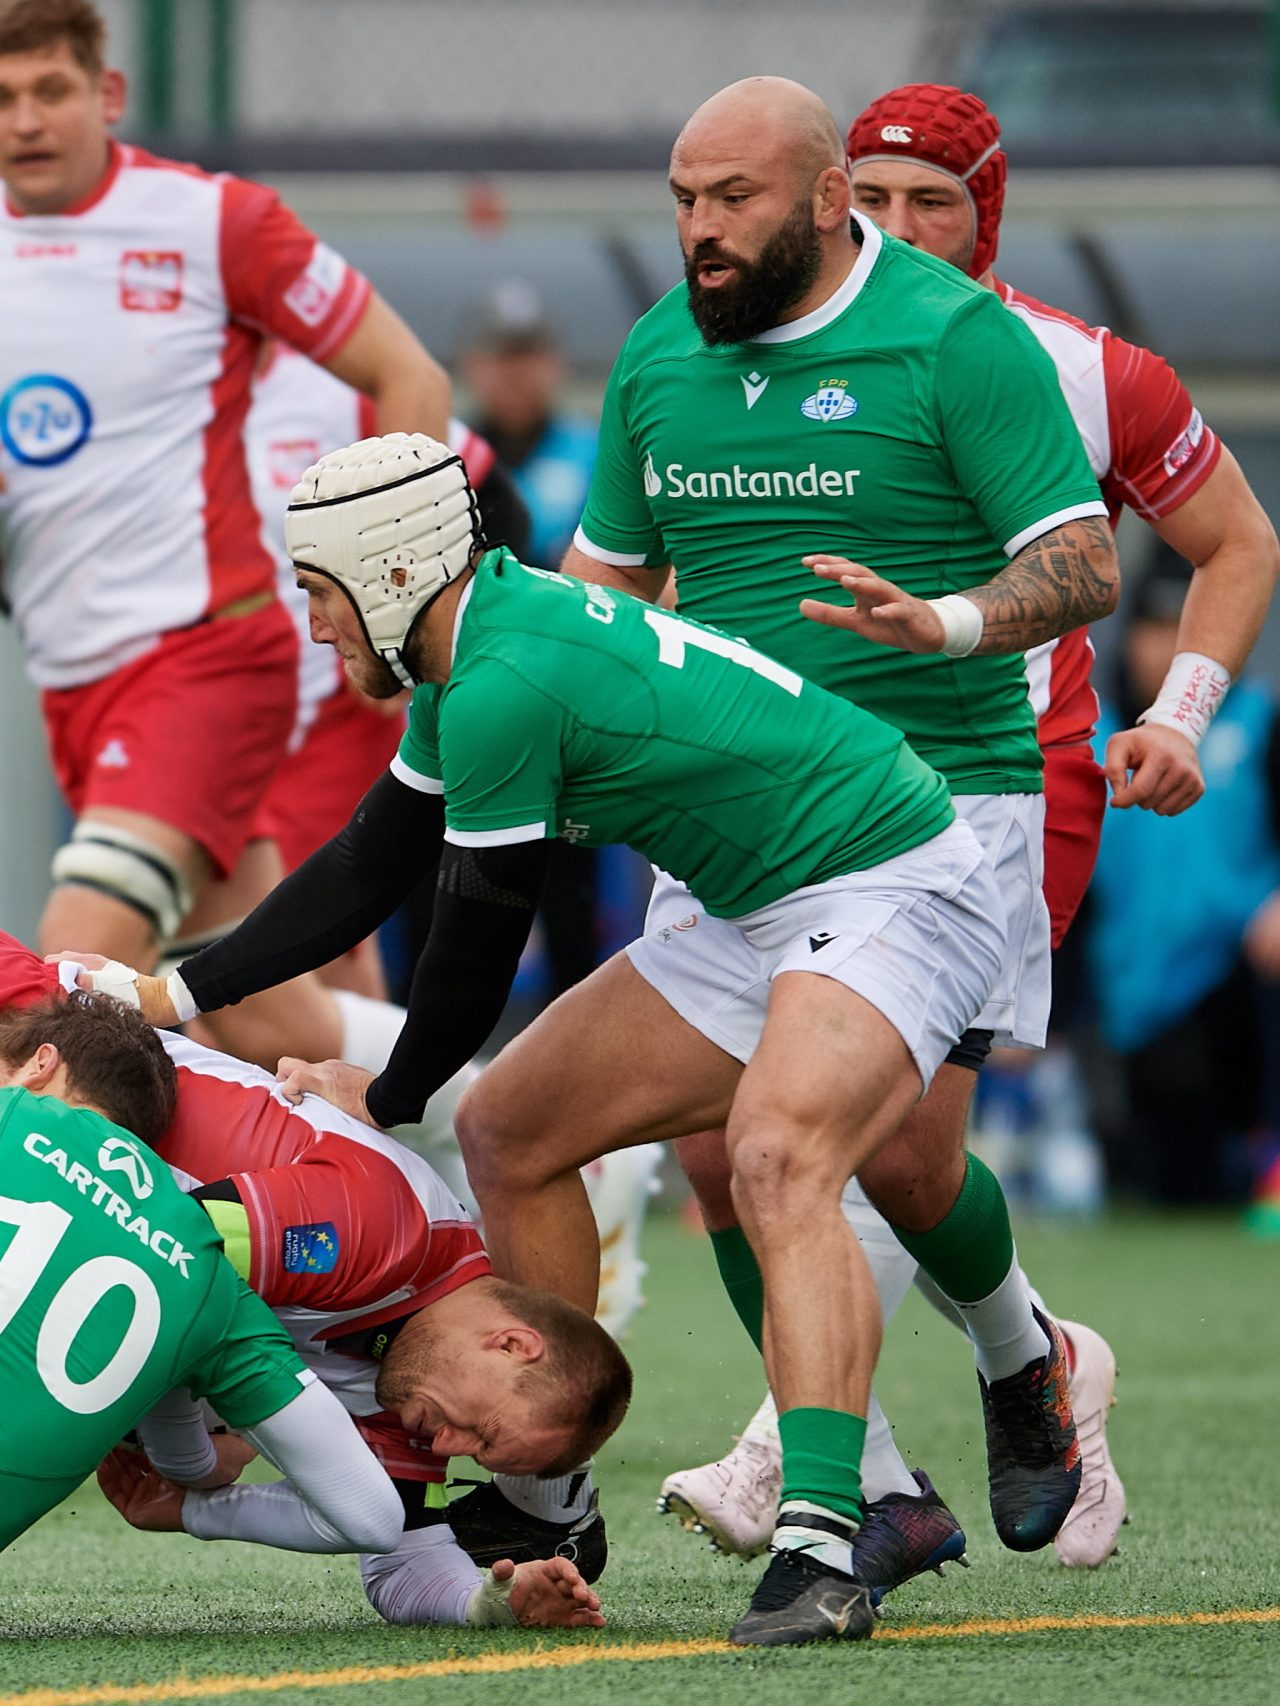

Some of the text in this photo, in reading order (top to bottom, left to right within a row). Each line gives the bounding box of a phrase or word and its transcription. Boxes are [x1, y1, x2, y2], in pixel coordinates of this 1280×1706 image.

[819, 378, 849, 388] FPR
[666, 463, 861, 498] Santander
[23, 1132, 196, 1280] CARTRACK
[284, 1231, 293, 1269] europe
[290, 1234, 299, 1266] rugby
